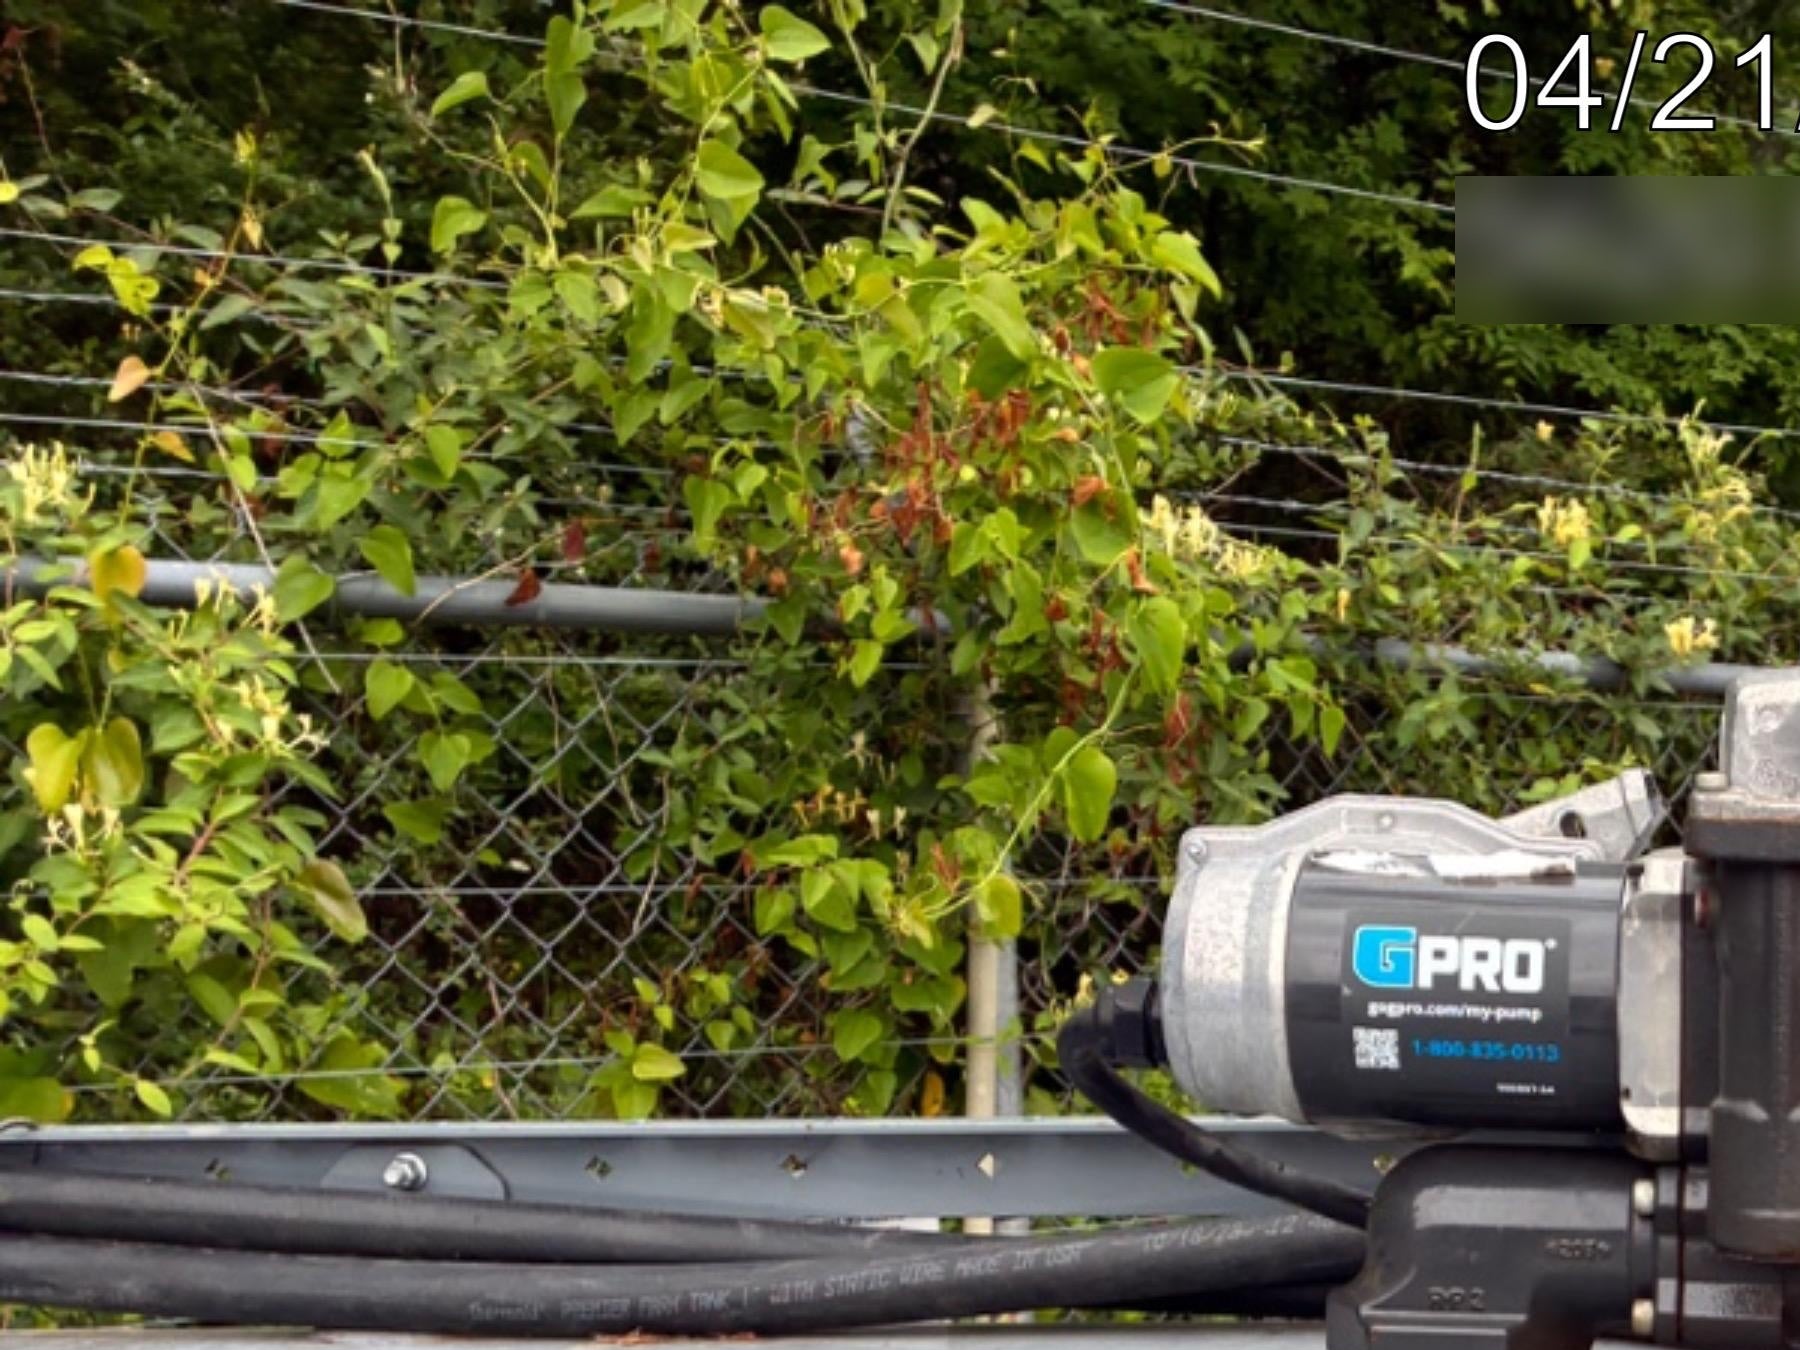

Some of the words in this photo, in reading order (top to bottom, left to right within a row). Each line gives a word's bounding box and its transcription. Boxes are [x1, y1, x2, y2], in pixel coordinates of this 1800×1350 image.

[1353, 925, 1546, 993] GPRO
[824, 1269, 892, 1298] STATIC
[900, 1258, 946, 1284] WIRE
[953, 1255, 1000, 1278] MADE
[1008, 1248, 1039, 1271] IN
